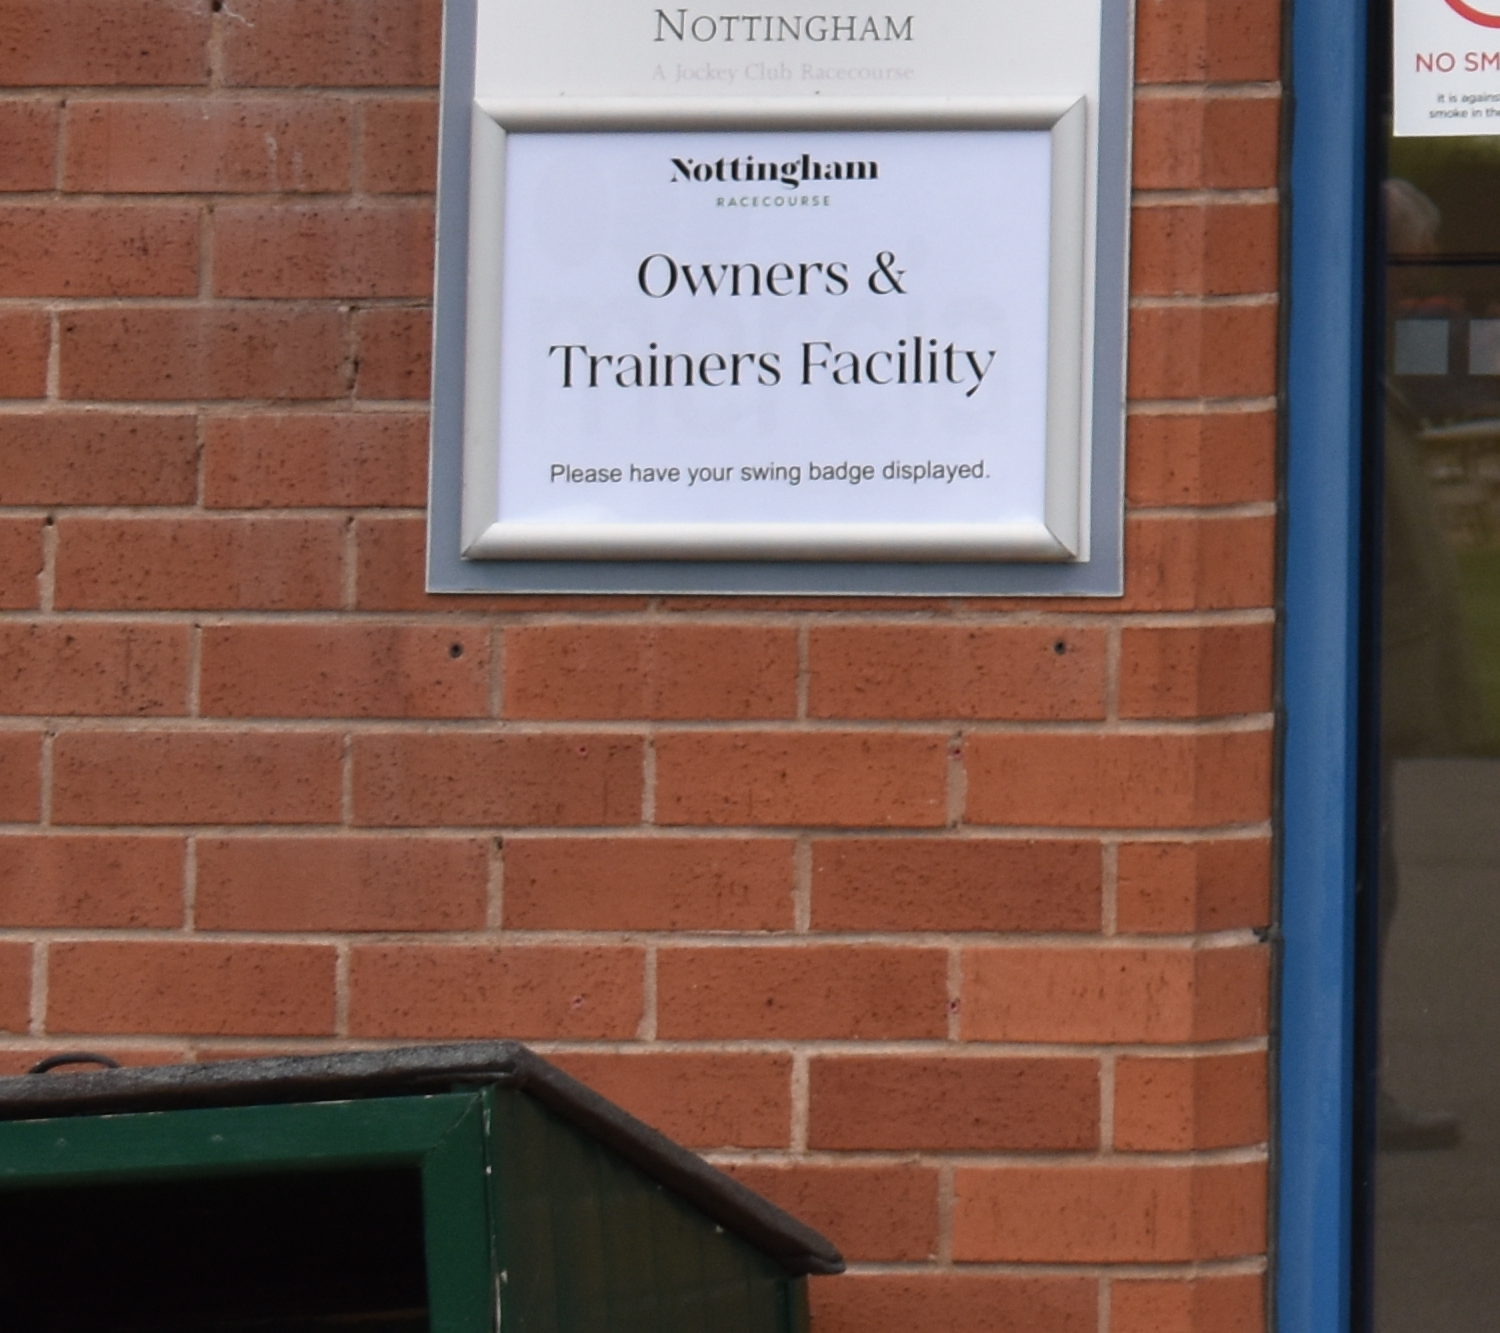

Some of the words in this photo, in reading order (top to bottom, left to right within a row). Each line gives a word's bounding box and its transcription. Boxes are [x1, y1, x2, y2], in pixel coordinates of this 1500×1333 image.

[655, 9, 912, 41] NOTTINGHAM
[653, 63, 666, 81] A
[676, 62, 738, 84] Jockey
[744, 61, 793, 80] Club
[800, 62, 913, 80] Racecourse
[1416, 53, 1455, 72] NO
[672, 154, 877, 188] Nottingham
[716, 196, 829, 207] RACECOURSE
[638, 255, 848, 296] Owners
[868, 252, 905, 294] &
[549, 342, 780, 388] Trainers
[802, 336, 995, 397] Facility
[551, 464, 622, 483] Please
[630, 464, 680, 482] have
[688, 467, 733, 486] your
[741, 462, 801, 487] swing
[809, 462, 874, 485] badge
[882, 460, 991, 484] displayed.
